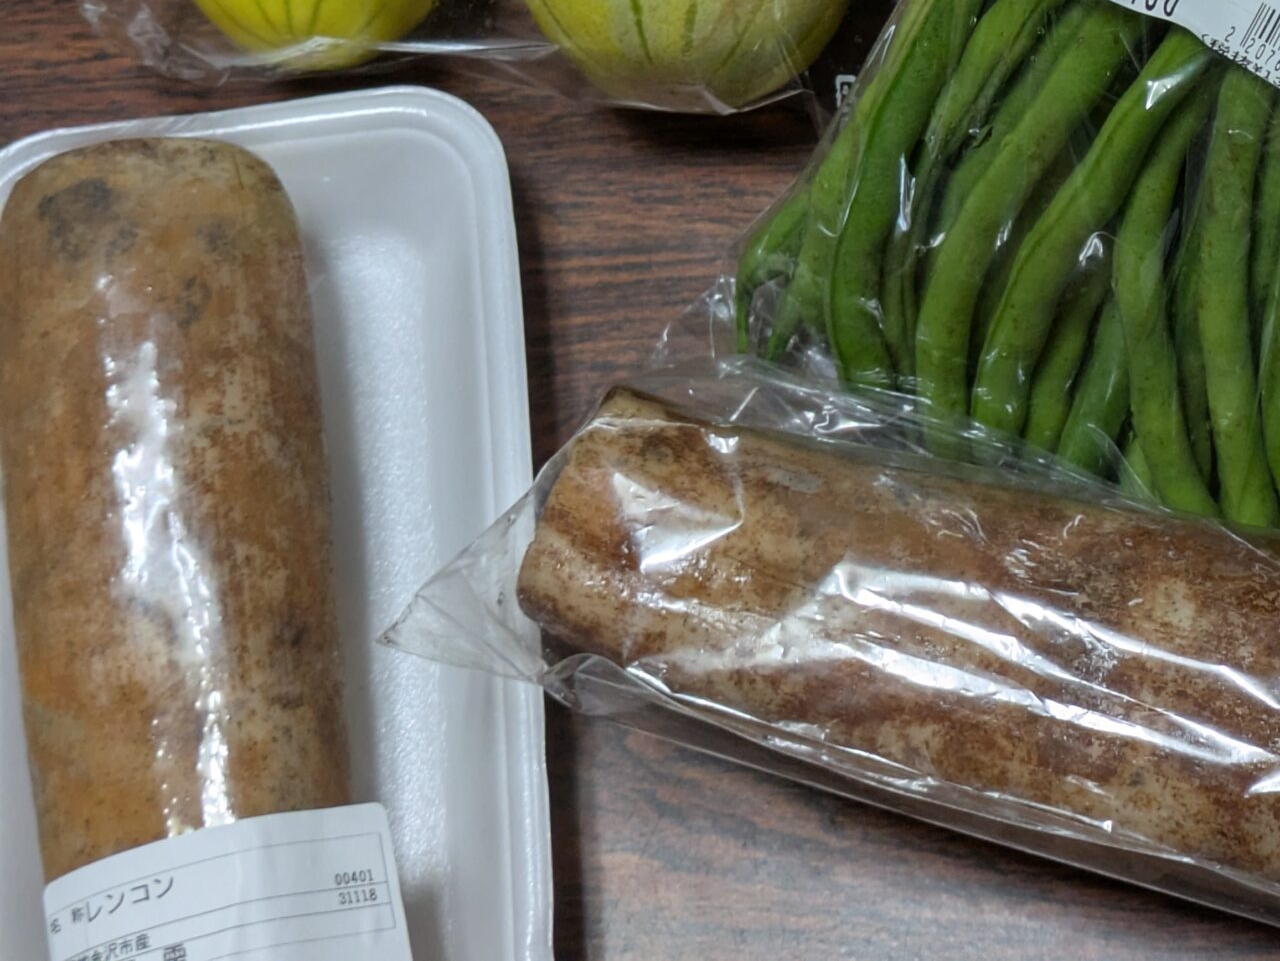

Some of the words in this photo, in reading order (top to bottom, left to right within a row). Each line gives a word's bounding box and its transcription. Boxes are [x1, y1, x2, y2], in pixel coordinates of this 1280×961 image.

[334, 868, 374, 886] 00401
[86, 876, 175, 921] レンコン
[338, 889, 378, 906] 31118
